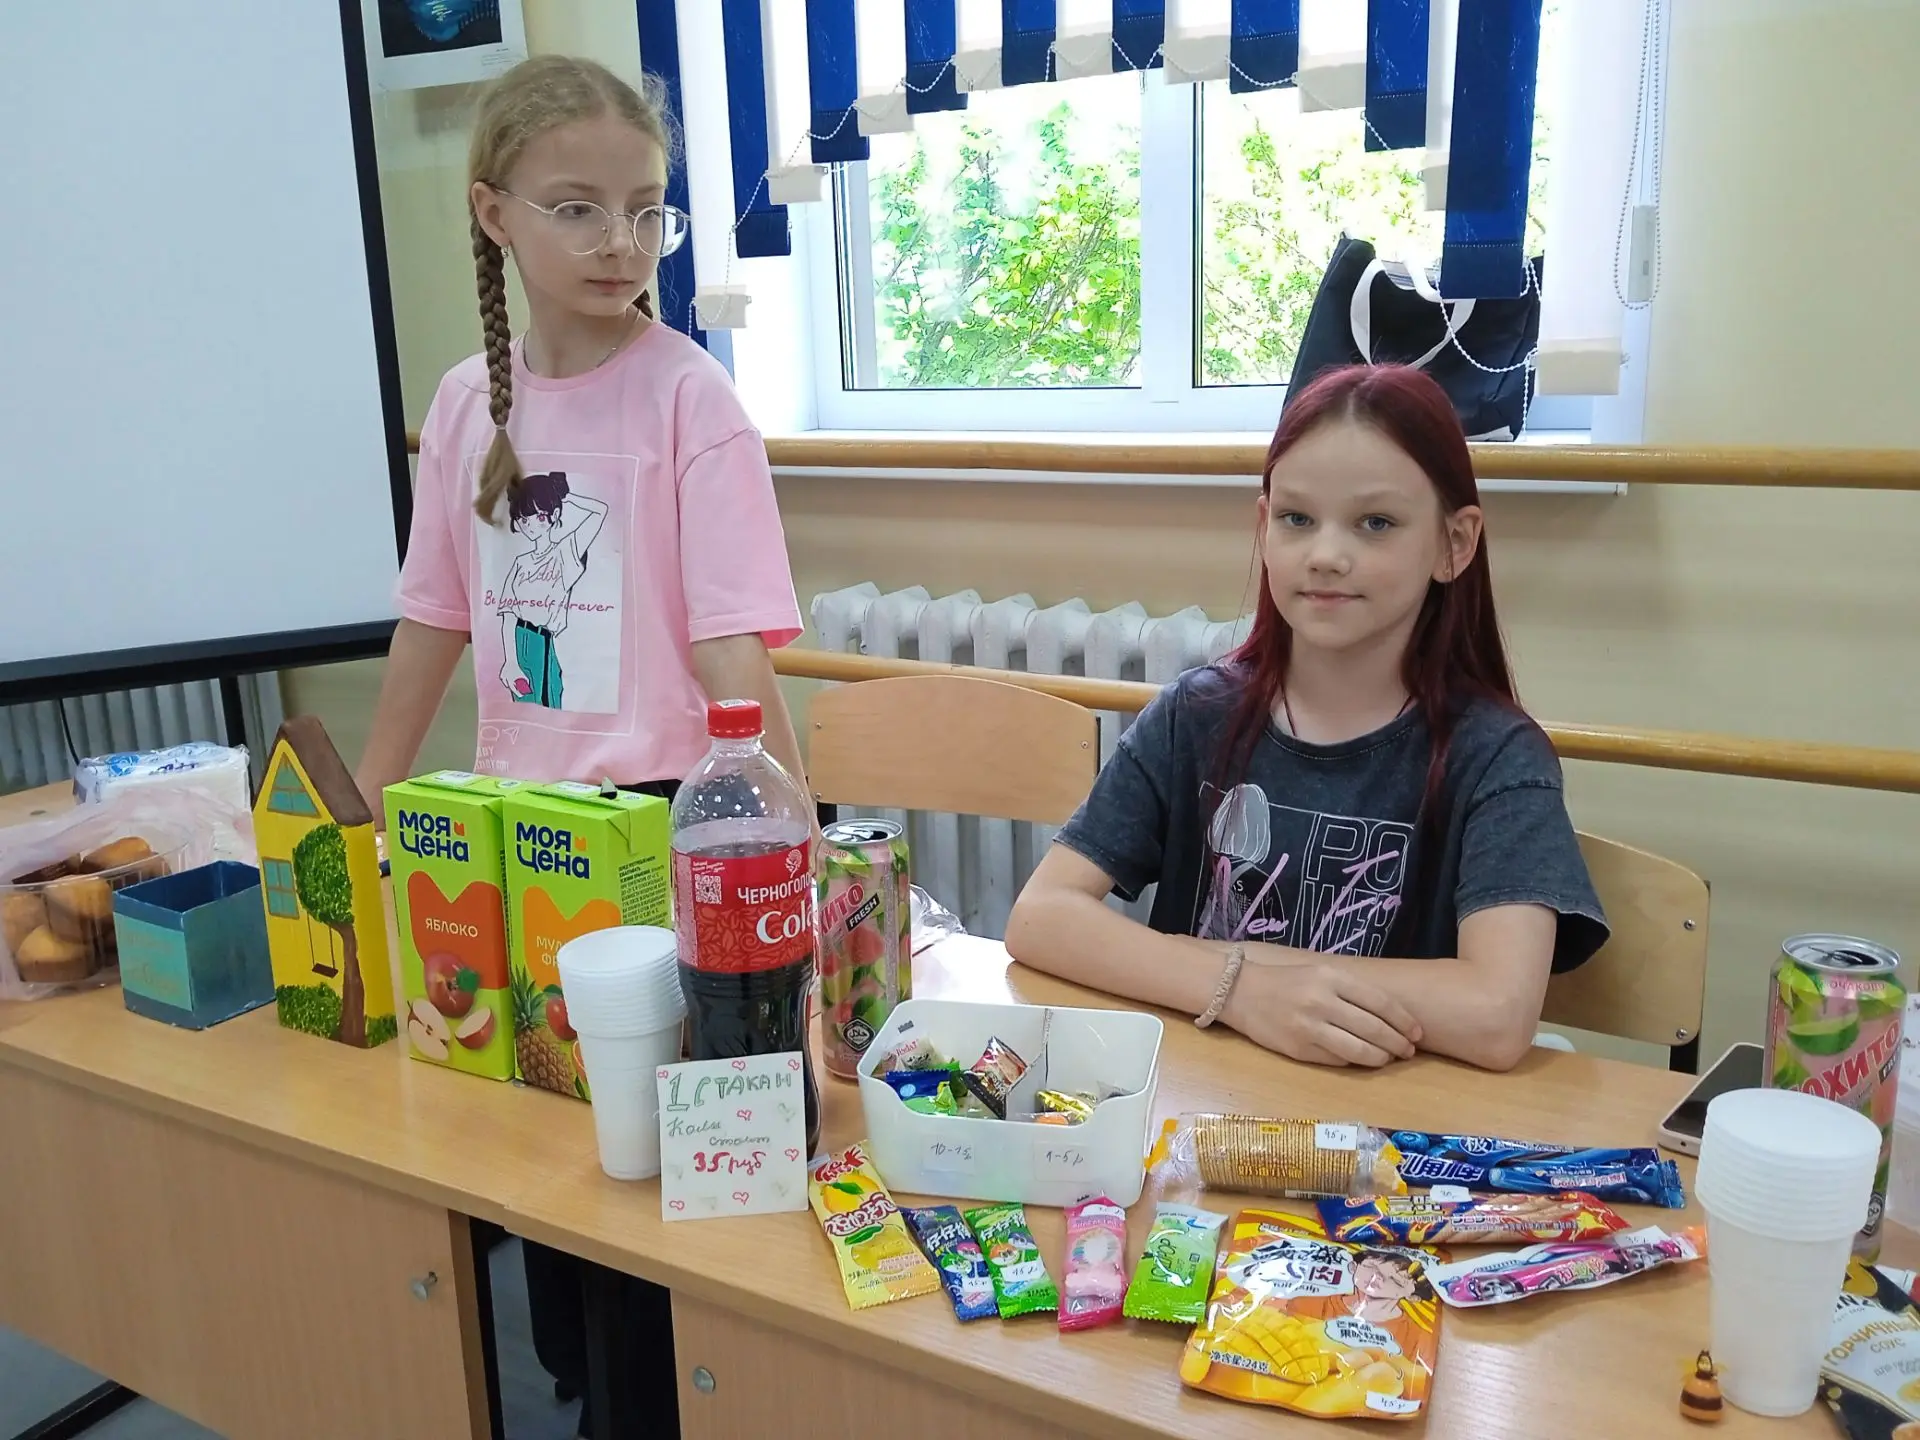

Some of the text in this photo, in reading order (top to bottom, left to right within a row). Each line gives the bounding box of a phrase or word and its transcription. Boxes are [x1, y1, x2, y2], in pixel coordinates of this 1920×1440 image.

[484, 589, 497, 607] Be
[499, 595, 556, 612] yourself
[737, 872, 812, 905] ЧЕРНОГОЛО
[425, 918, 479, 938] ЯБЛОКО
[849, 897, 878, 929] FRESH
[536, 936, 563, 952] МУЛ
[1790, 1019, 1900, 1101] ОХИТО
[667, 1072, 791, 1112] 1 СТАКАН
